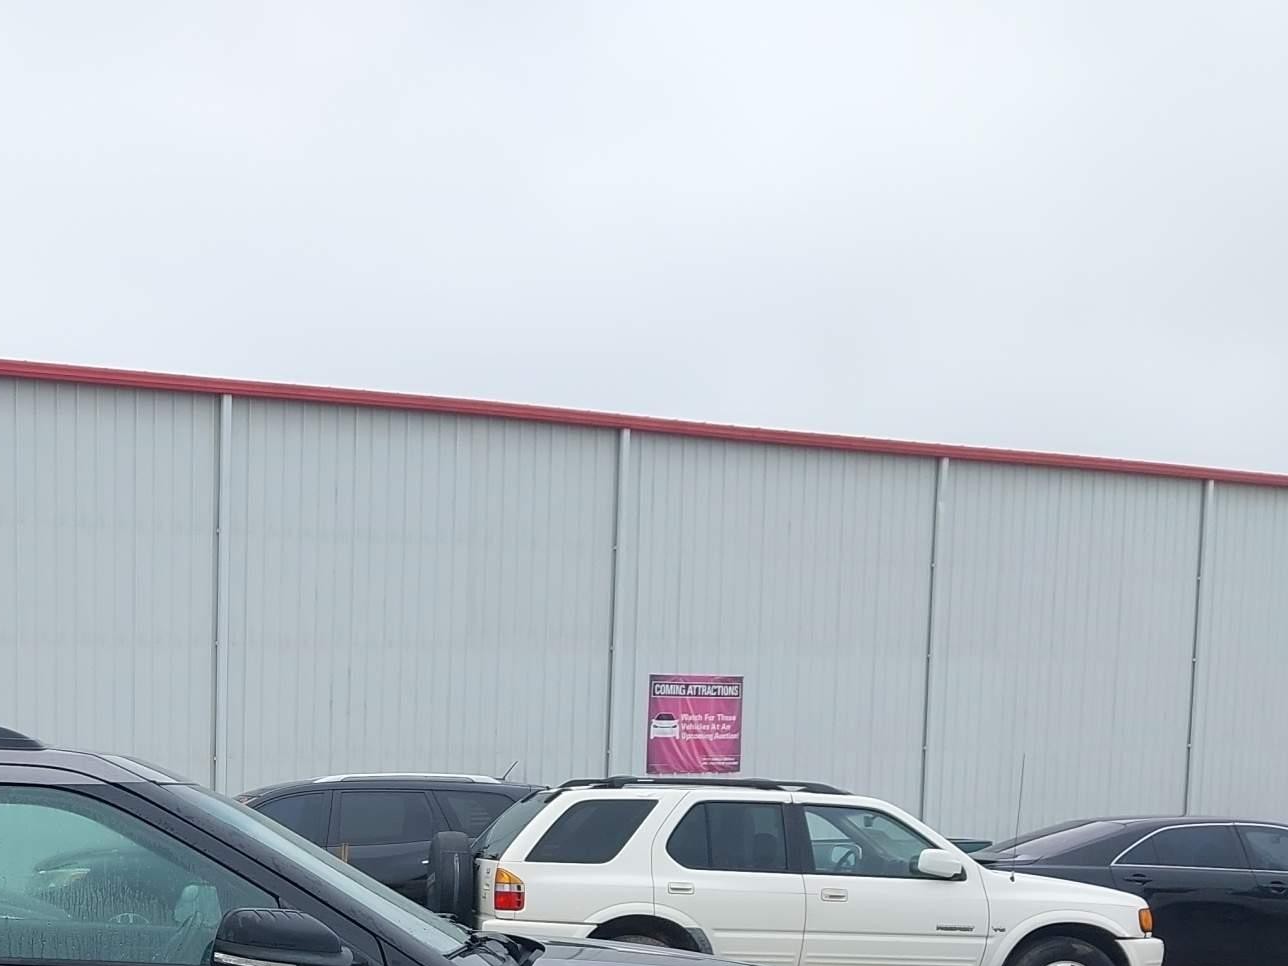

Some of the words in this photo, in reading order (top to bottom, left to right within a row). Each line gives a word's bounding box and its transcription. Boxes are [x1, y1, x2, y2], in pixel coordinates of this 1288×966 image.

[654, 683, 686, 696] COMING
[686, 685, 739, 697] ATTRACTIONS
[681, 713, 702, 721] Watch
[704, 713, 715, 721] For
[681, 723, 710, 731] Vehicles
